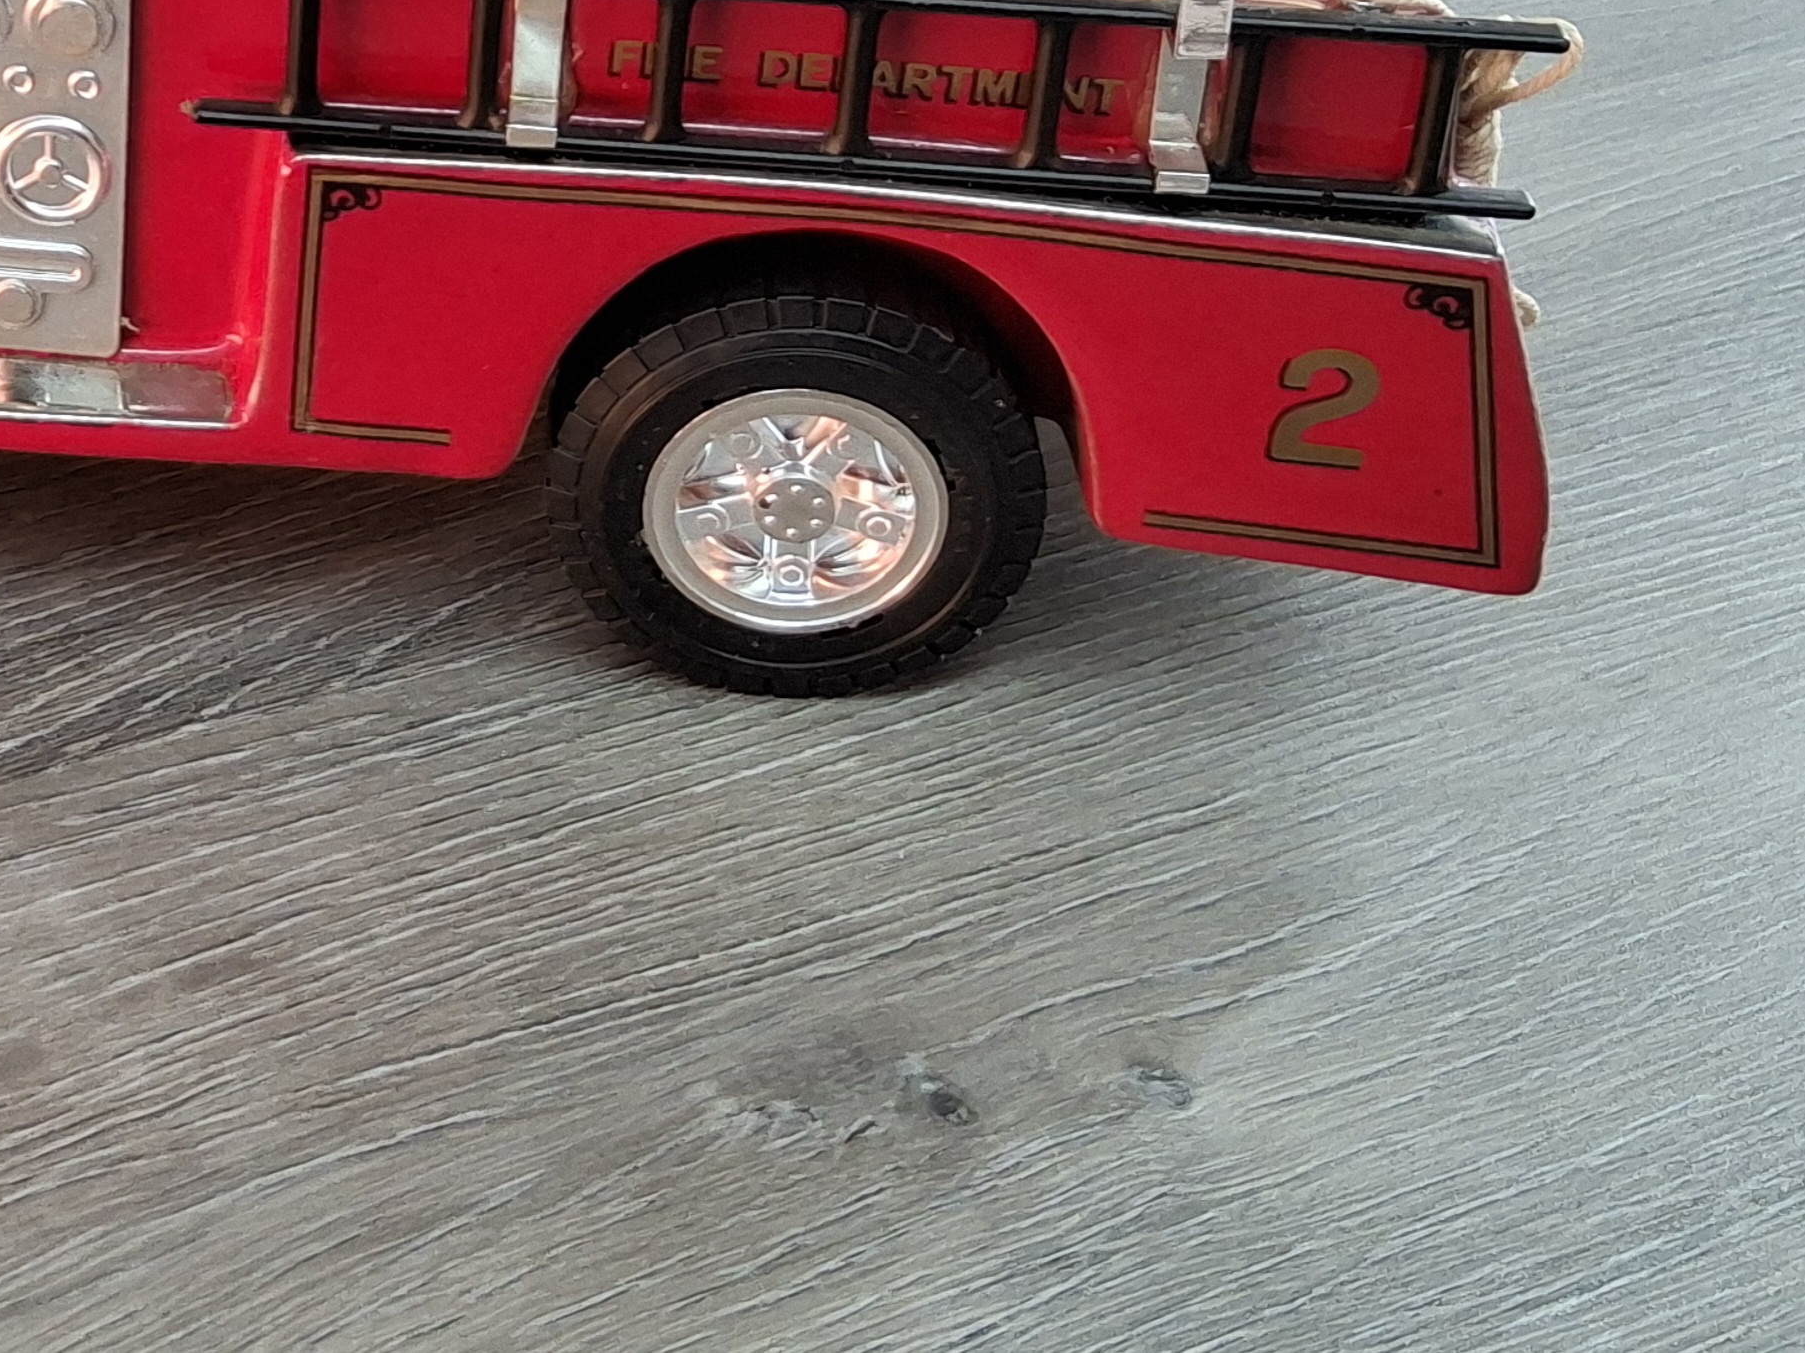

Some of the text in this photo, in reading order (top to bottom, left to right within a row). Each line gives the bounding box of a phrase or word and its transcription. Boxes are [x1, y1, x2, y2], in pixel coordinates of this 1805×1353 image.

[608, 39, 1127, 116] FIE DEARTMNT
[1266, 347, 1382, 470] 2
